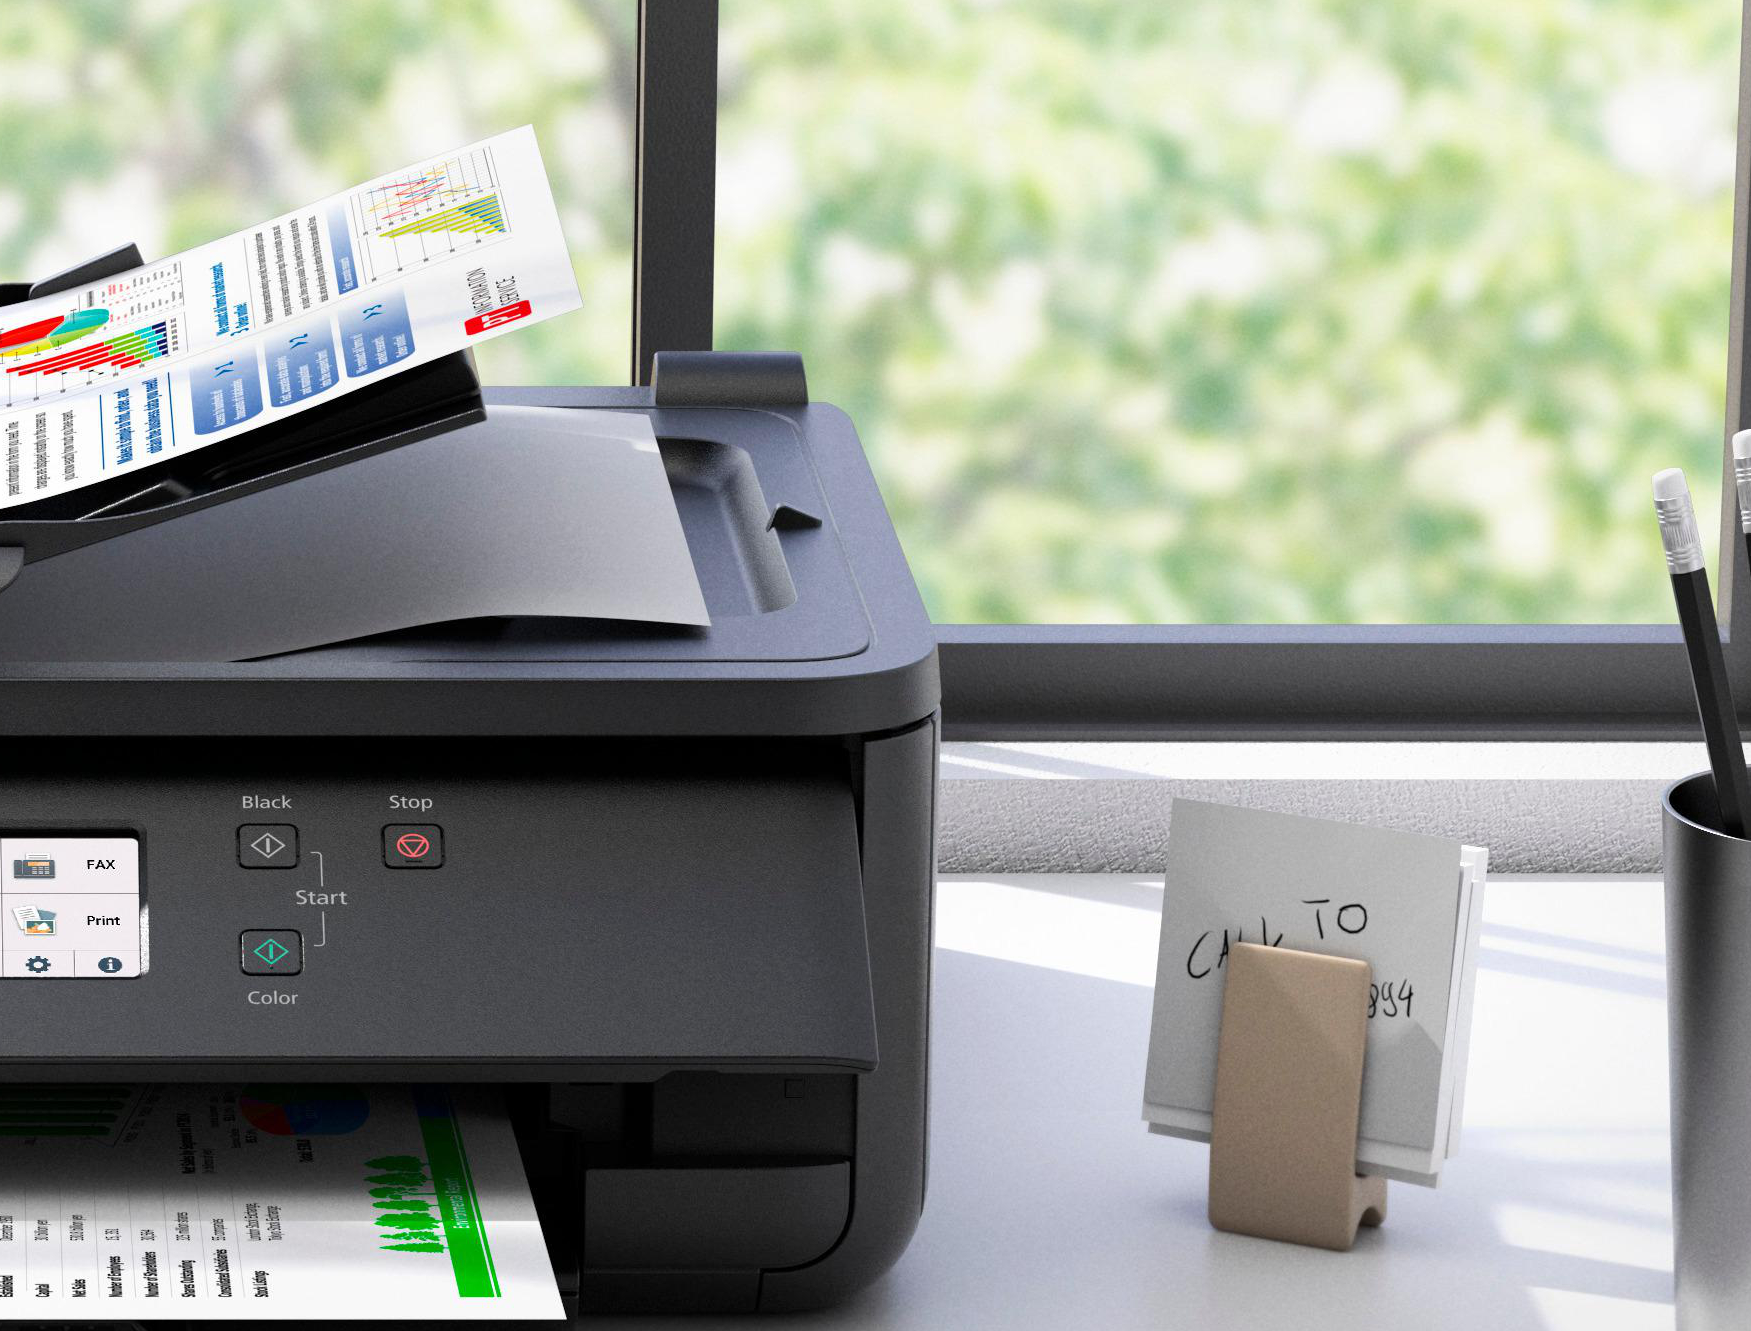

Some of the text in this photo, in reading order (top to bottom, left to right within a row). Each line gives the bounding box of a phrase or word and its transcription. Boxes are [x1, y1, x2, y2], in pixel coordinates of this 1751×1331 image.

[465, 267, 494, 315] INFORMATION
[496, 275, 520, 305] SERVICE
[242, 795, 292, 809] Black
[389, 795, 433, 813] Stop
[87, 859, 116, 870] FAX
[295, 889, 348, 905] Start
[87, 915, 121, 926] Print
[1302, 899, 1368, 939] TO
[247, 990, 299, 1005] Color
[106, 1256, 124, 1276] Employees
[178, 1260, 195, 1298] Shares Outstanding
[251, 1270, 269, 1298] Stock Listings
[34, 1283, 53, 1298] Capital
[107, 1282, 122, 1298] Number
